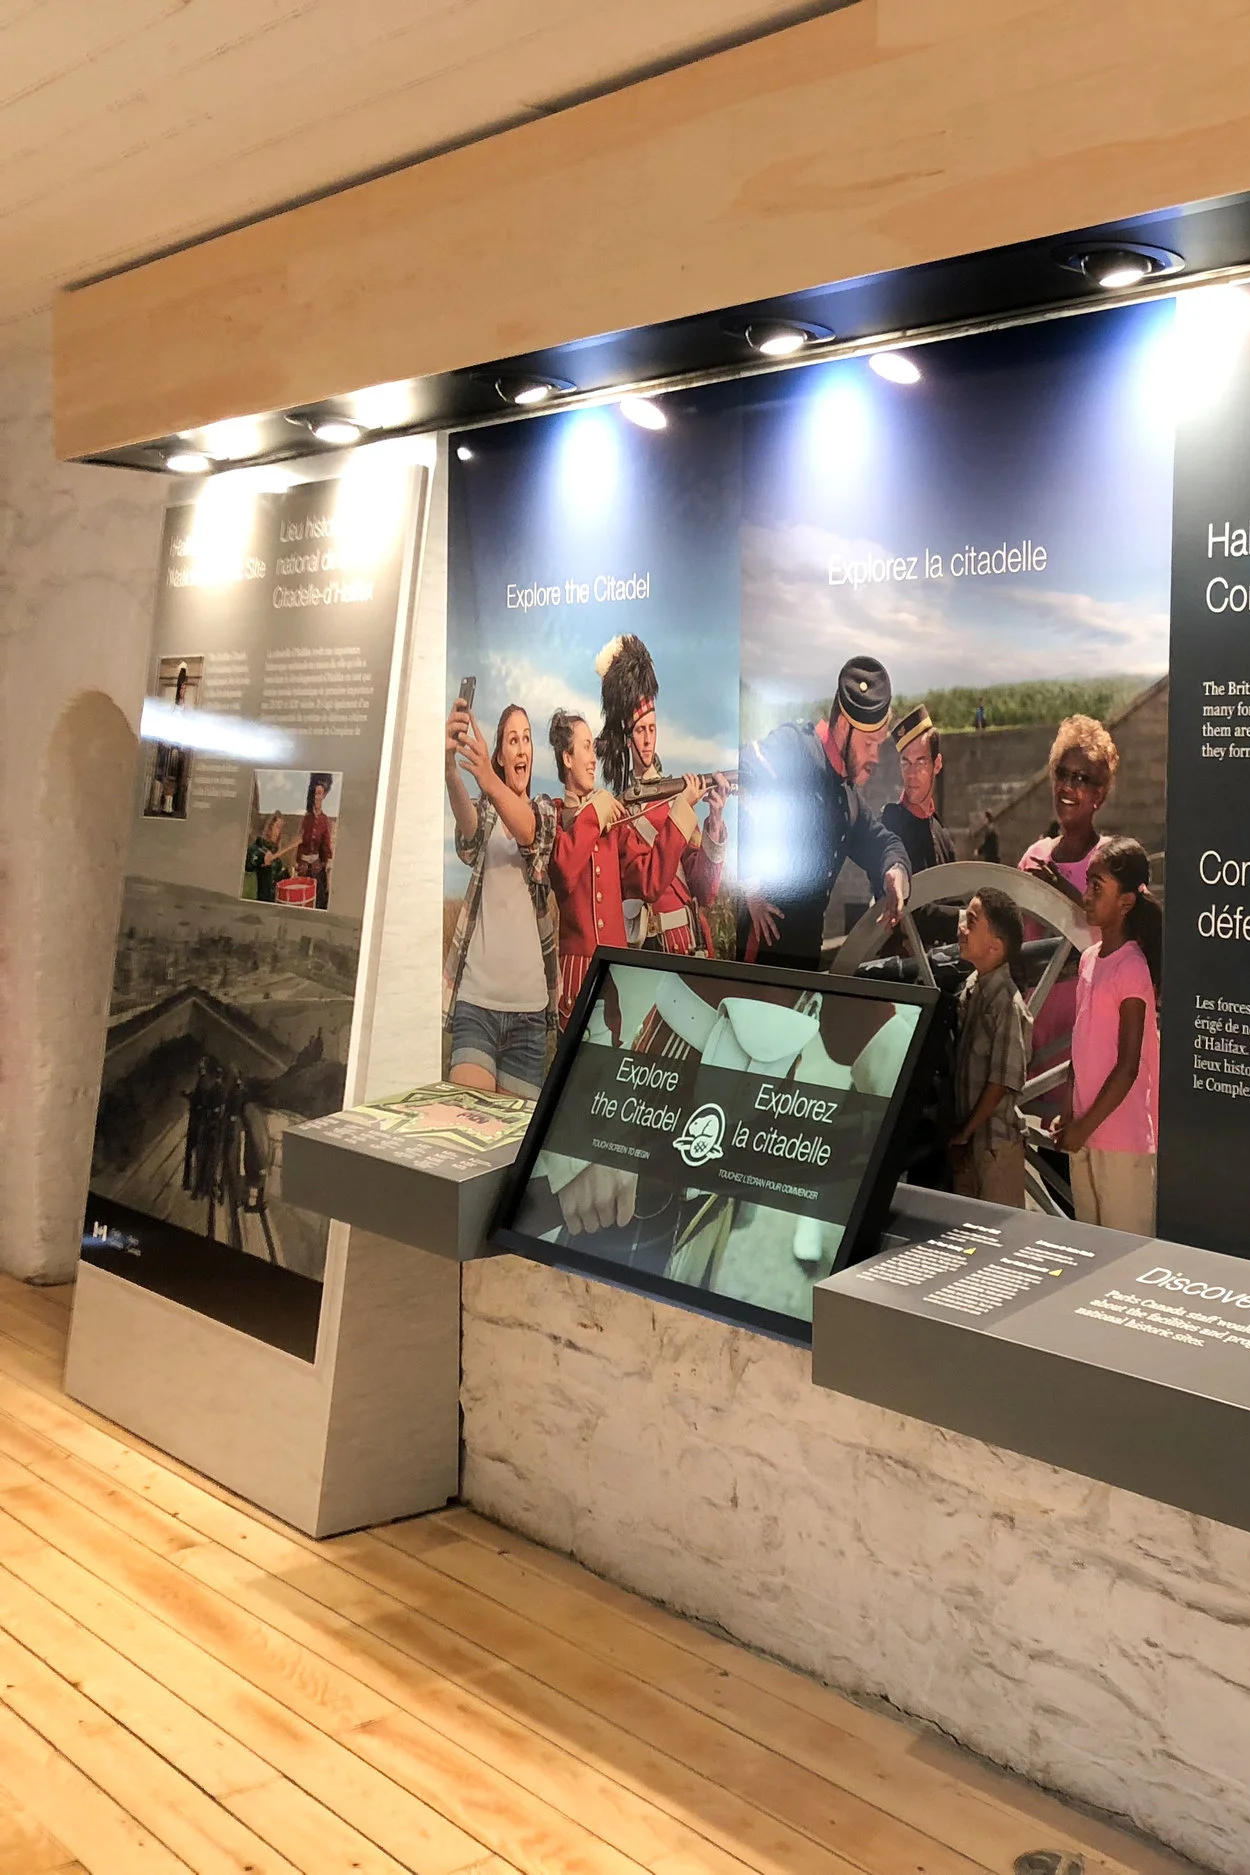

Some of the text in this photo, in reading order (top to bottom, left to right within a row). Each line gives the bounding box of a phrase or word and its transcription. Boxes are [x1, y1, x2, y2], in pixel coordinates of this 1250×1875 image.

[828, 541, 1048, 590] Explorez la citadelle
[507, 572, 650, 613] Explore the Citadel
[1203, 681, 1225, 695] The
[1202, 706, 1235, 719] many
[1202, 722, 1231, 736] them
[1201, 742, 1226, 760] they
[1195, 995, 1215, 1010] Les
[1217, 997, 1250, 1014] forces
[1194, 1015, 1222, 1034] érigé
[1225, 1018, 1239, 1033] de
[1194, 1035, 1248, 1055] d'Halifax.
[616, 1057, 679, 1092] Explore
[591, 1092, 681, 1132] the Citadel
[755, 1084, 838, 1124] Explorez
[732, 1121, 831, 1166] la citadelle
